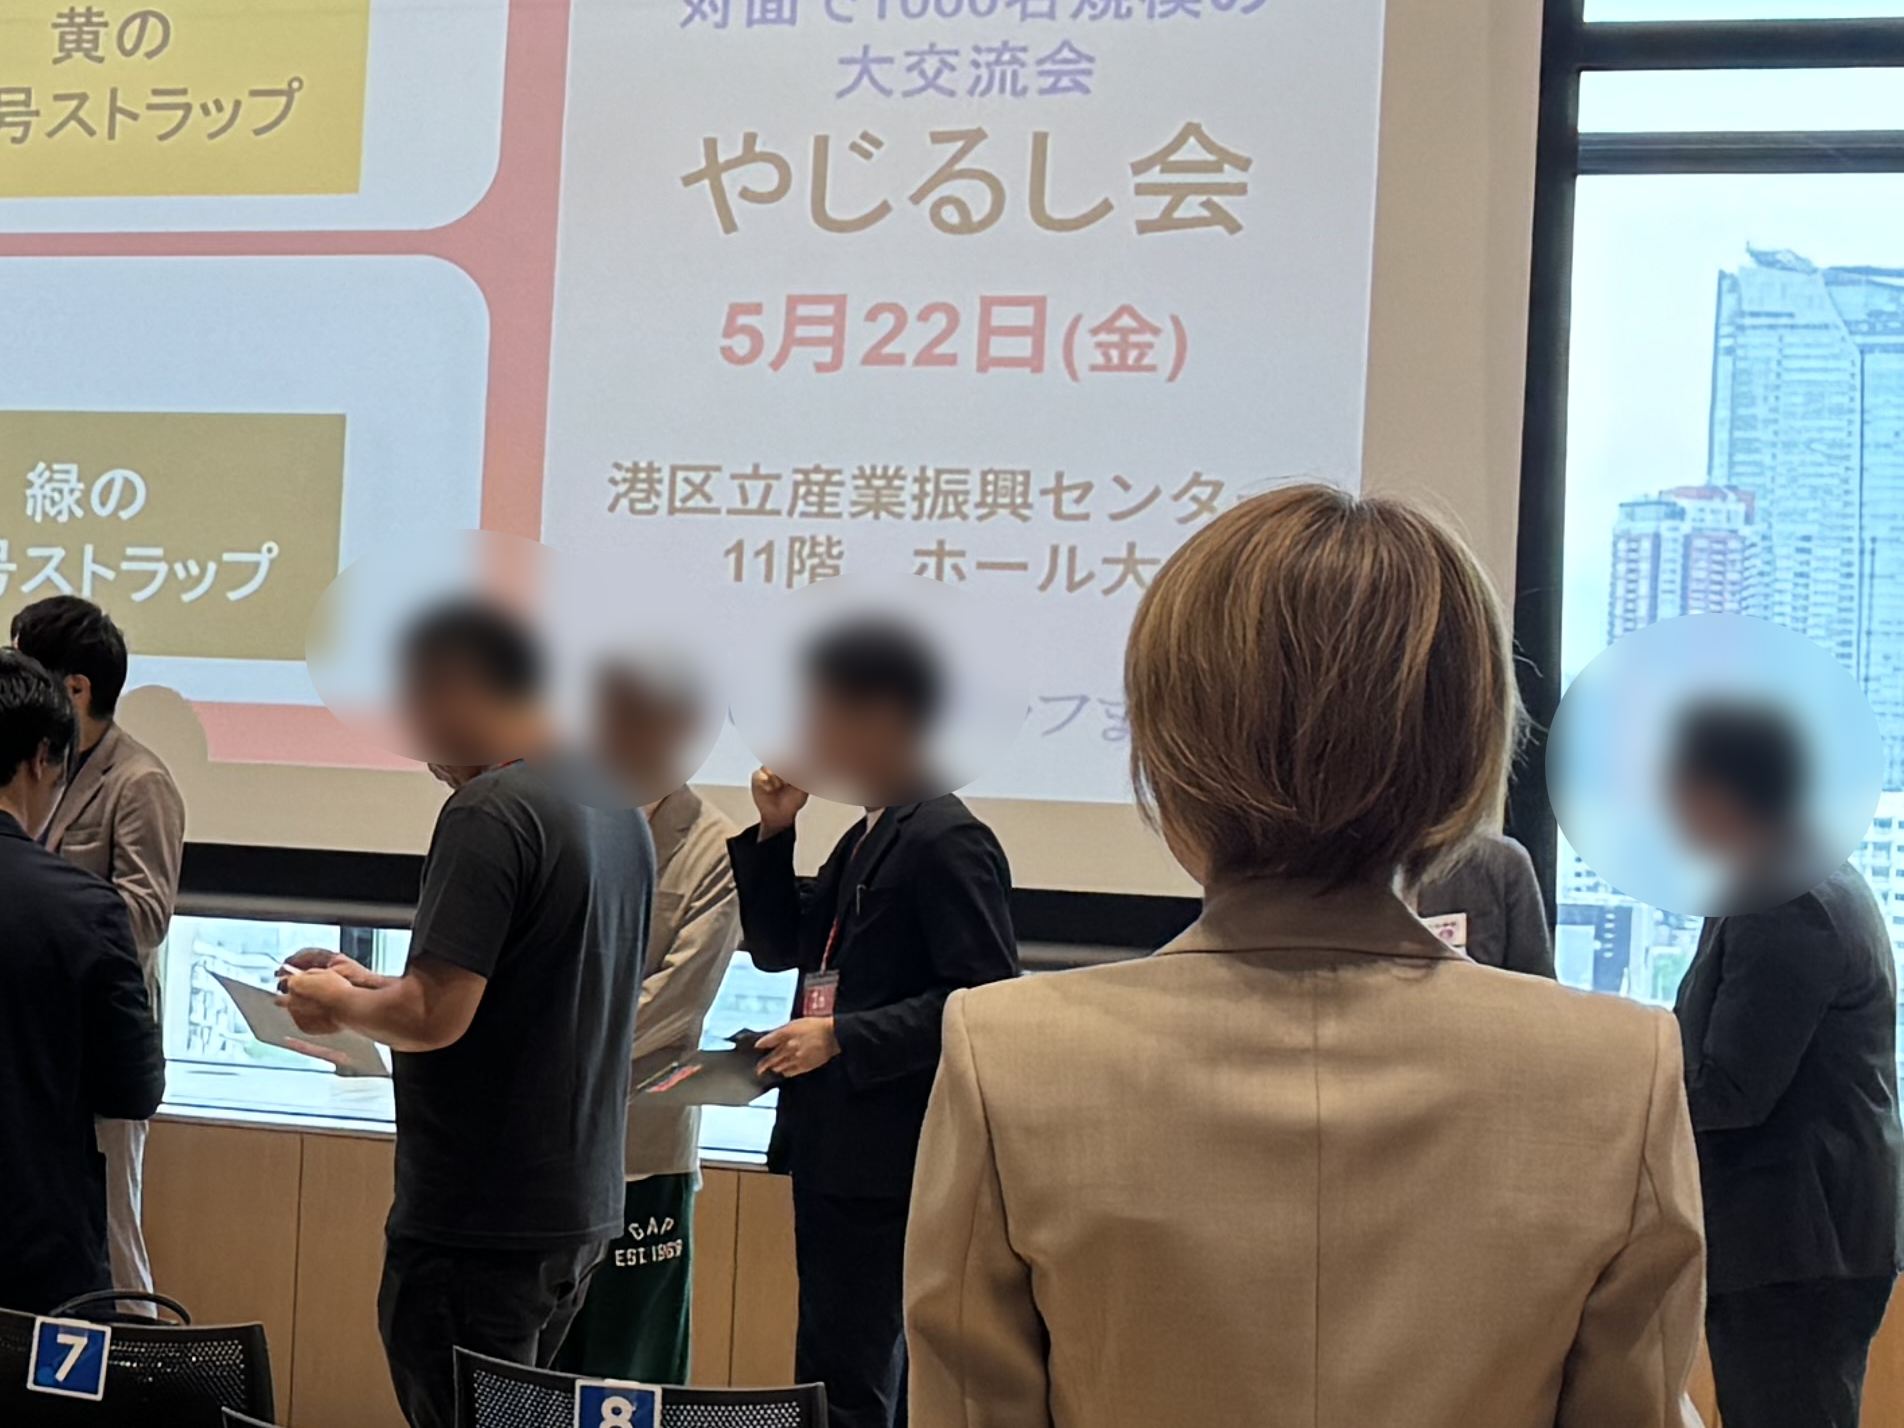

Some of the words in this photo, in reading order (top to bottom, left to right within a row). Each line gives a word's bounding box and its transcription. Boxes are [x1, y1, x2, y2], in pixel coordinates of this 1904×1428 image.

[51, 5, 172, 65] 黄の
[833, 38, 1098, 100] 大交流会
[680, 120, 1255, 238] やじるし会
[718, 292, 1191, 384] 5月22日(金)
[24, 460, 148, 524] 緑の
[722, 533, 846, 589] 11階
[628, 1216, 675, 1241] GAP
[54, 1334, 89, 1383] 7
